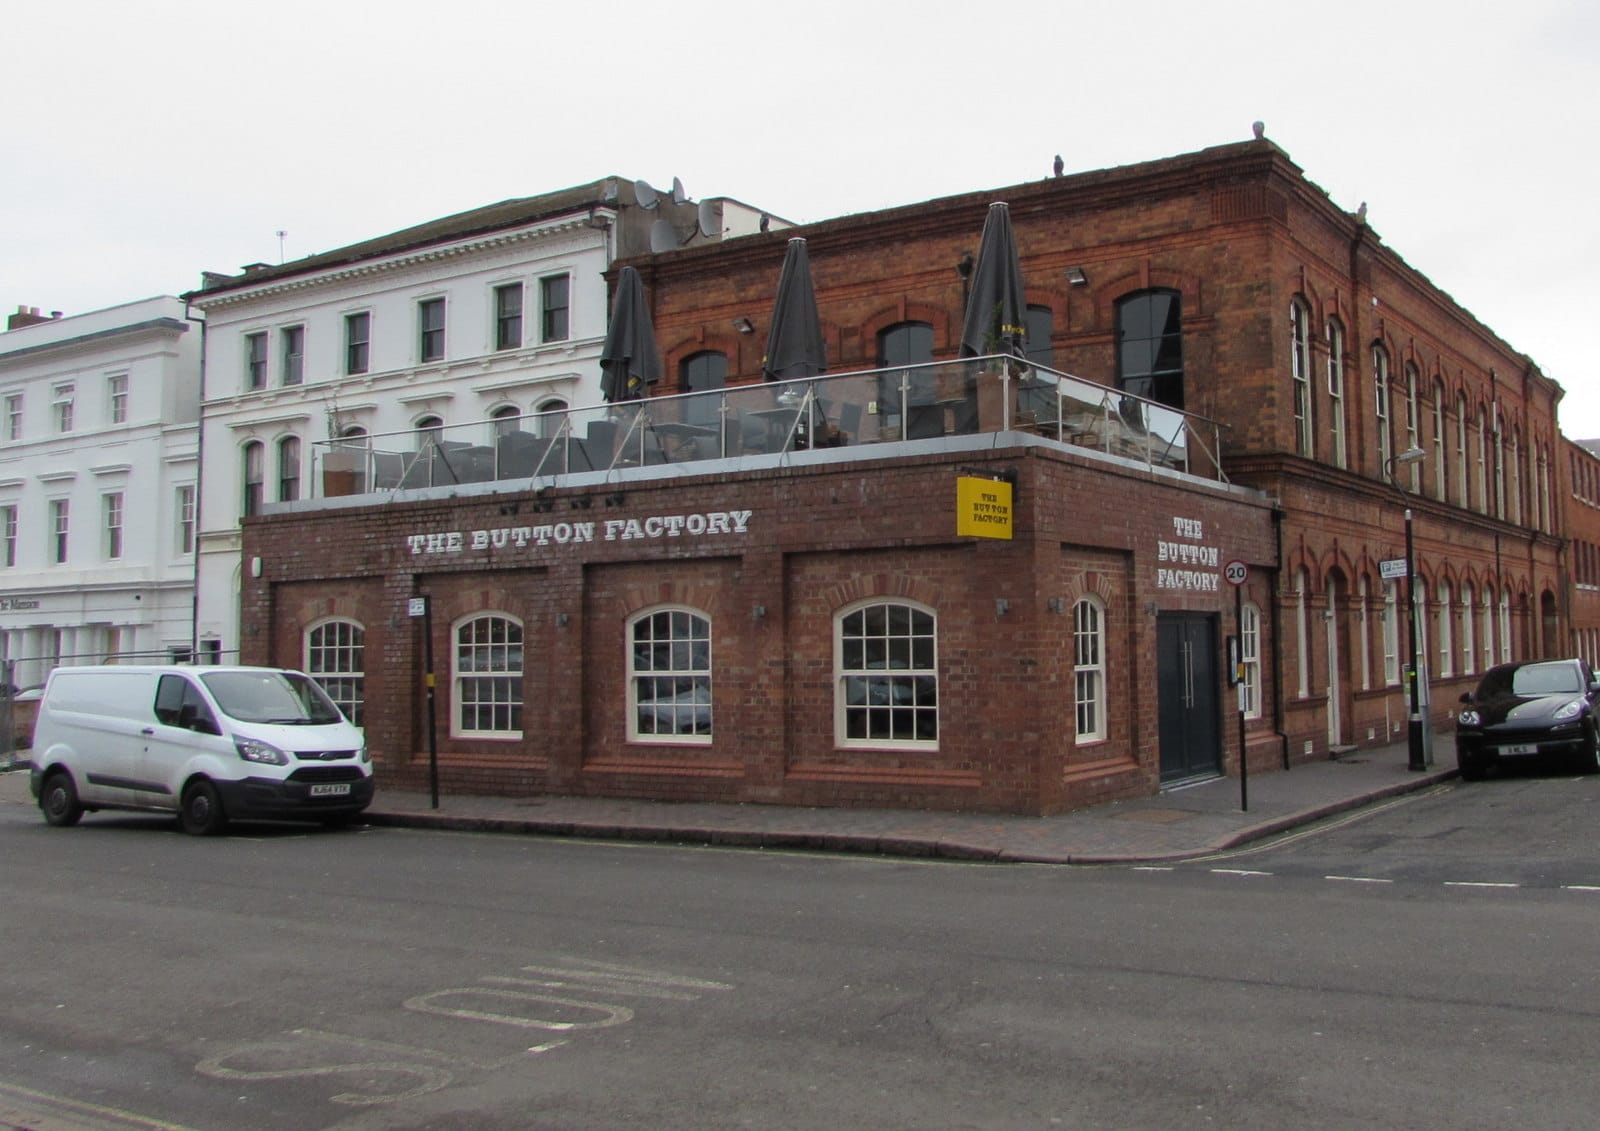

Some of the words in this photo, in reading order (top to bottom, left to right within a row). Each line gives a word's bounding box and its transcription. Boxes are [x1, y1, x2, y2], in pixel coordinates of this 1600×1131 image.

[981, 493, 997, 502] THE
[973, 503, 1008, 514] BUTTON
[973, 513, 1008, 524] FACTORY
[407, 532, 463, 555] THE
[471, 522, 596, 550] BUTTON
[604, 509, 753, 541] FACTORY
[1173, 516, 1202, 539] THE
[1157, 540, 1218, 567] BUTTON
[1157, 568, 1219, 591] FACTORY
[1227, 567, 1245, 579] 20
